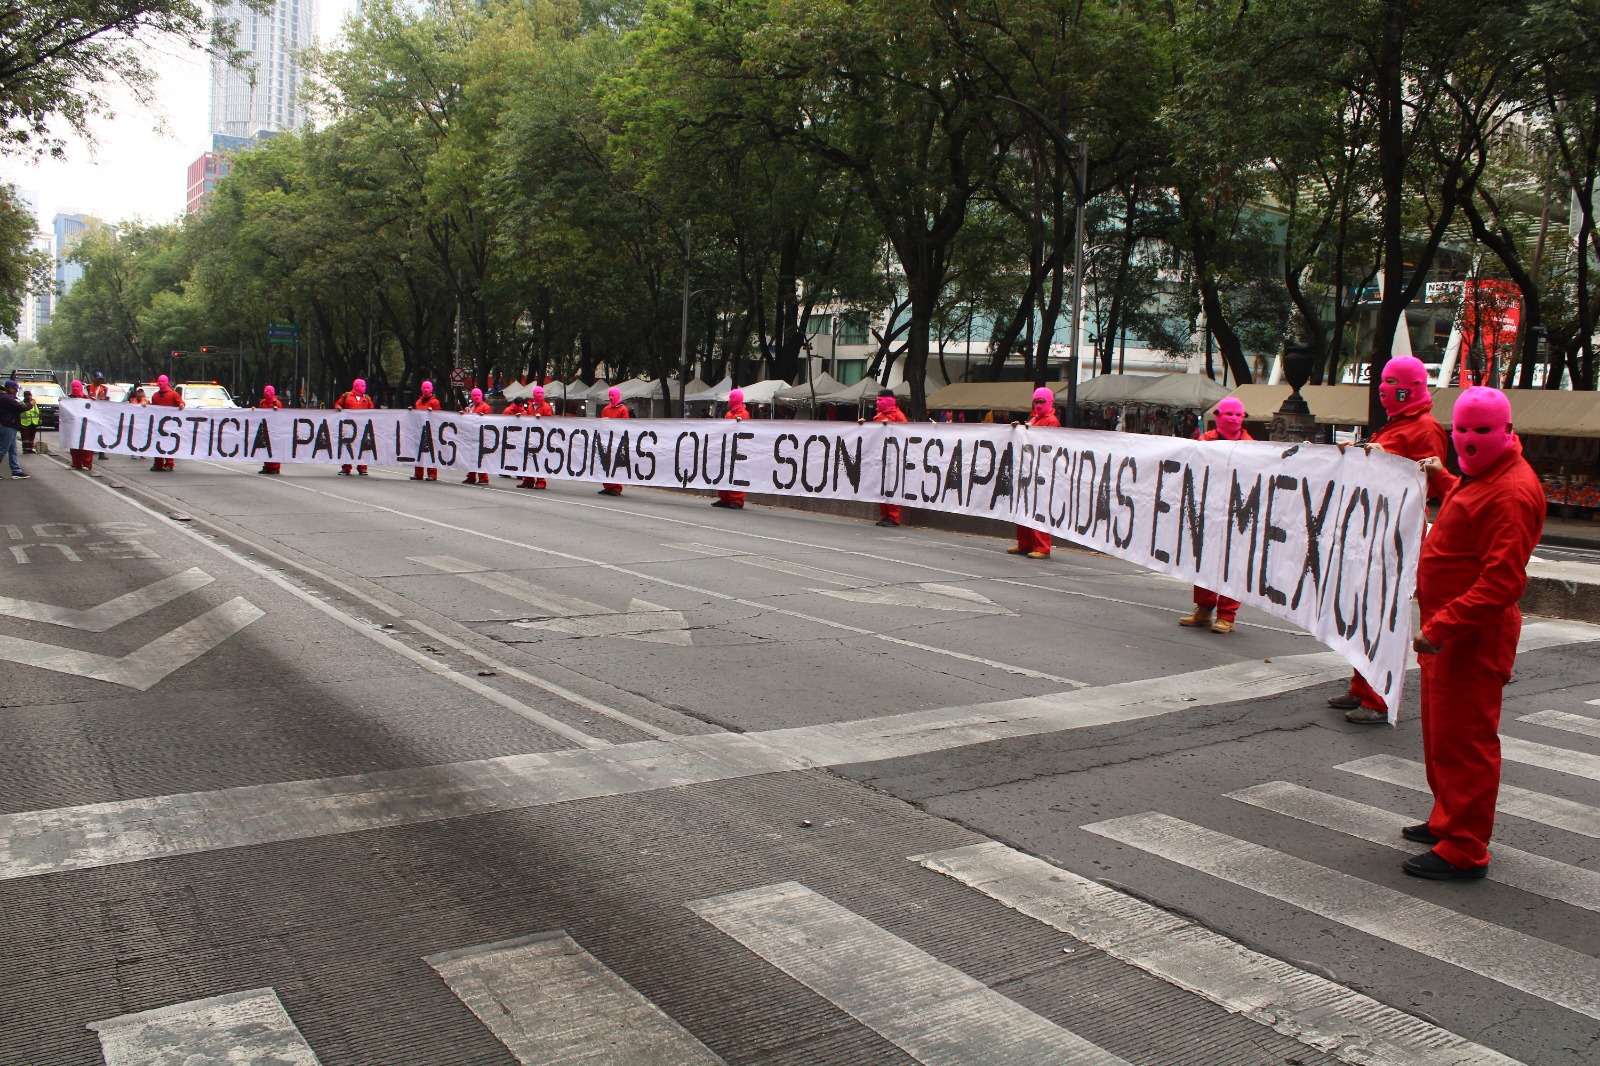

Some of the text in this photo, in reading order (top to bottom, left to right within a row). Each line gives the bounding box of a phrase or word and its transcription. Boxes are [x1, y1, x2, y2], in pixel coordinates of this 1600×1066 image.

[291, 417, 378, 461] PARA
[396, 420, 458, 466] LAS
[477, 424, 658, 481] PERSONAS
[674, 431, 755, 488] QUE
[772, 433, 863, 494] SON
[880, 436, 1137, 550] DESAPARECIDAS
[1150, 459, 1210, 573] EN
